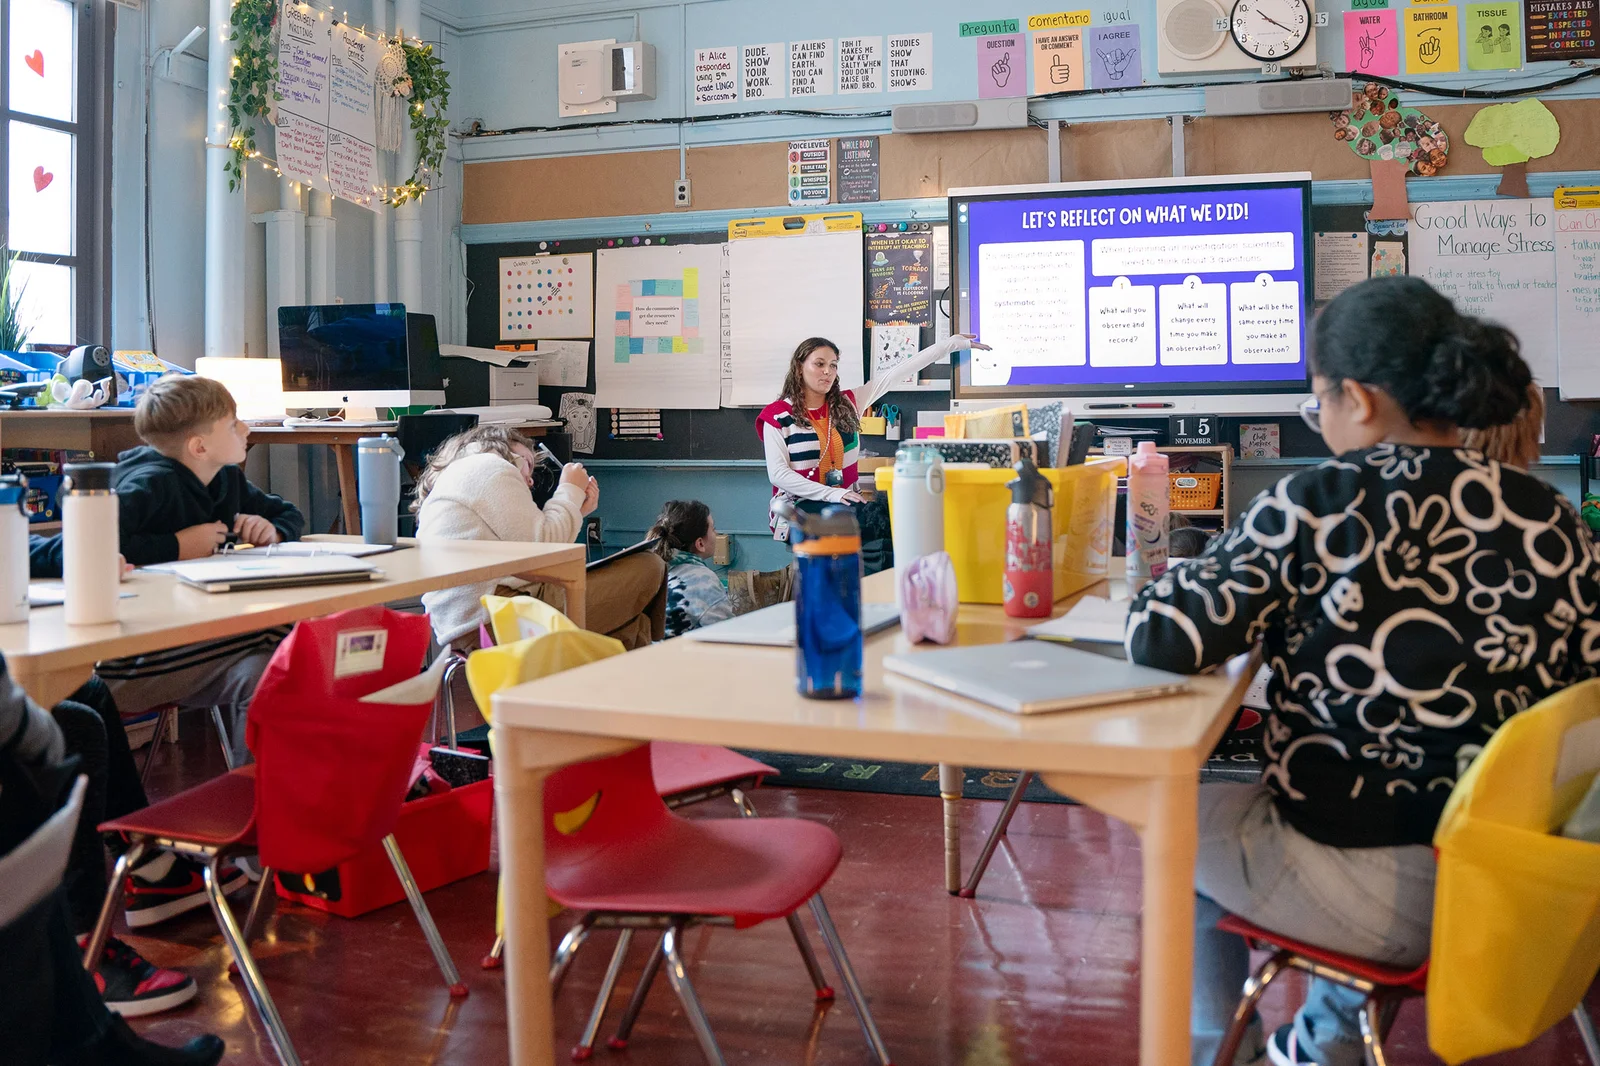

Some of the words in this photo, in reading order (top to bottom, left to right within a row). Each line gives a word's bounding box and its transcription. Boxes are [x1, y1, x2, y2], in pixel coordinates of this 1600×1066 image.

[1240, 4, 1248, 12] 10
[1530, 2, 1572, 12] MISTAKES
[1103, 10, 1131, 23] igual
[1413, 12, 1448, 21] BATHROOM
[1477, 9, 1507, 18] TISSUE
[1548, 10, 1588, 19] EXPECTED
[1028, 13, 1089, 28] Comentario
[1236, 18, 1243, 27] 9
[1298, 15, 1304, 24] 3
[1314, 13, 1326, 24] 15
[1359, 16, 1381, 25] WATER
[961, 20, 1016, 35] Pregunta
[1216, 19, 1228, 29] 45
[1548, 20, 1592, 29] RESPECTED
[1102, 32, 1131, 40] AGREE
[1241, 33, 1247, 43] 8
[1293, 30, 1300, 38] 4
[1548, 30, 1591, 39] INSPECTED
[890, 39, 920, 47] STUDIES
[1058, 35, 1079, 43] ANSWER
[792, 44, 798, 52] IF
[801, 42, 826, 51] ALIENS
[986, 39, 1015, 49] QUESTION
[1048, 42, 1074, 50] COMMENT.
[1253, 44, 1259, 53] 7
[1283, 42, 1289, 51] 5
[1549, 40, 1595, 49] CORRECTED
[745, 47, 769, 57] DUDE.
[864, 46, 873, 54] ME
[890, 49, 912, 57] SHOW
[1268, 46, 1275, 56] 6
[699, 52, 705, 61] If
[709, 52, 727, 61] Alice
[809, 51, 825, 59] FIND
[841, 54, 854, 62] LOW
[745, 57, 770, 67] SHOW
[792, 60, 817, 69] EARTH.
[841, 61, 861, 69] SALTY
[890, 59, 909, 67] THAT
[696, 62, 731, 72] responded
[841, 68, 854, 76] YOU
[855, 67, 874, 75] DON'T
[1265, 63, 1278, 73] 30
[696, 73, 713, 82] using
[715, 72, 727, 80] 5th
[745, 68, 767, 77] YOUR
[792, 69, 806, 77] YOU
[808, 68, 823, 76] CAN
[890, 68, 927, 77] STUDYING.
[745, 77, 772, 87] WORK.
[792, 78, 808, 86] FIND
[841, 75, 859, 83] RAISE
[890, 78, 916, 87] SHOWS
[696, 84, 713, 92] Grade
[715, 81, 734, 90] LINGO
[792, 86, 816, 95] PENCIL
[745, 88, 765, 97] BRO.
[701, 93, 730, 102] Sarcasm
[788, 142, 807, 150] VOICE
[808, 141, 829, 149] LEVELS
[841, 141, 858, 150] WHOLE
[859, 140, 873, 149] BODY
[792, 152, 797, 161] 3
[844, 150, 870, 159] LISTENING
[792, 165, 797, 174] 2
[1022, 210, 1056, 229] LET'S
[1060, 207, 1116, 227] REFLECT
[1119, 206, 1142, 225] ON
[1146, 204, 1187, 224] WHAT
[1191, 203, 1212, 222] WE
[1216, 202, 1249, 221] DID!
[1414, 203, 1468, 231] Good
[1474, 203, 1517, 236] Ways
[1526, 203, 1547, 227] to
[1558, 213, 1583, 231] Can
[1438, 234, 1500, 260] Manage
[1507, 232, 1555, 252] Stress
[1428, 267, 1453, 279] fidget
[1467, 269, 1486, 278] stress
[1487, 268, 1501, 281] toy
[1190, 281, 1195, 290] 2
[1261, 279, 1267, 287] 3
[1468, 281, 1483, 290] talk
[1486, 281, 1494, 290] to
[1497, 279, 1521, 290] friend
[1522, 281, 1530, 289] or
[1532, 280, 1557, 289] teacher
[1177, 302, 1195, 310] What
[1170, 316, 1194, 324] change
[1256, 318, 1277, 326] every
[1108, 335, 1138, 343] record?
[1175, 343, 1221, 352] observation?
[1243, 345, 1290, 354] observation?
[1177, 418, 1187, 436] 1
[1198, 418, 1210, 436] 5
[1175, 437, 1211, 445] NOVEMBER
[1256, 449, 1265, 457] 20
